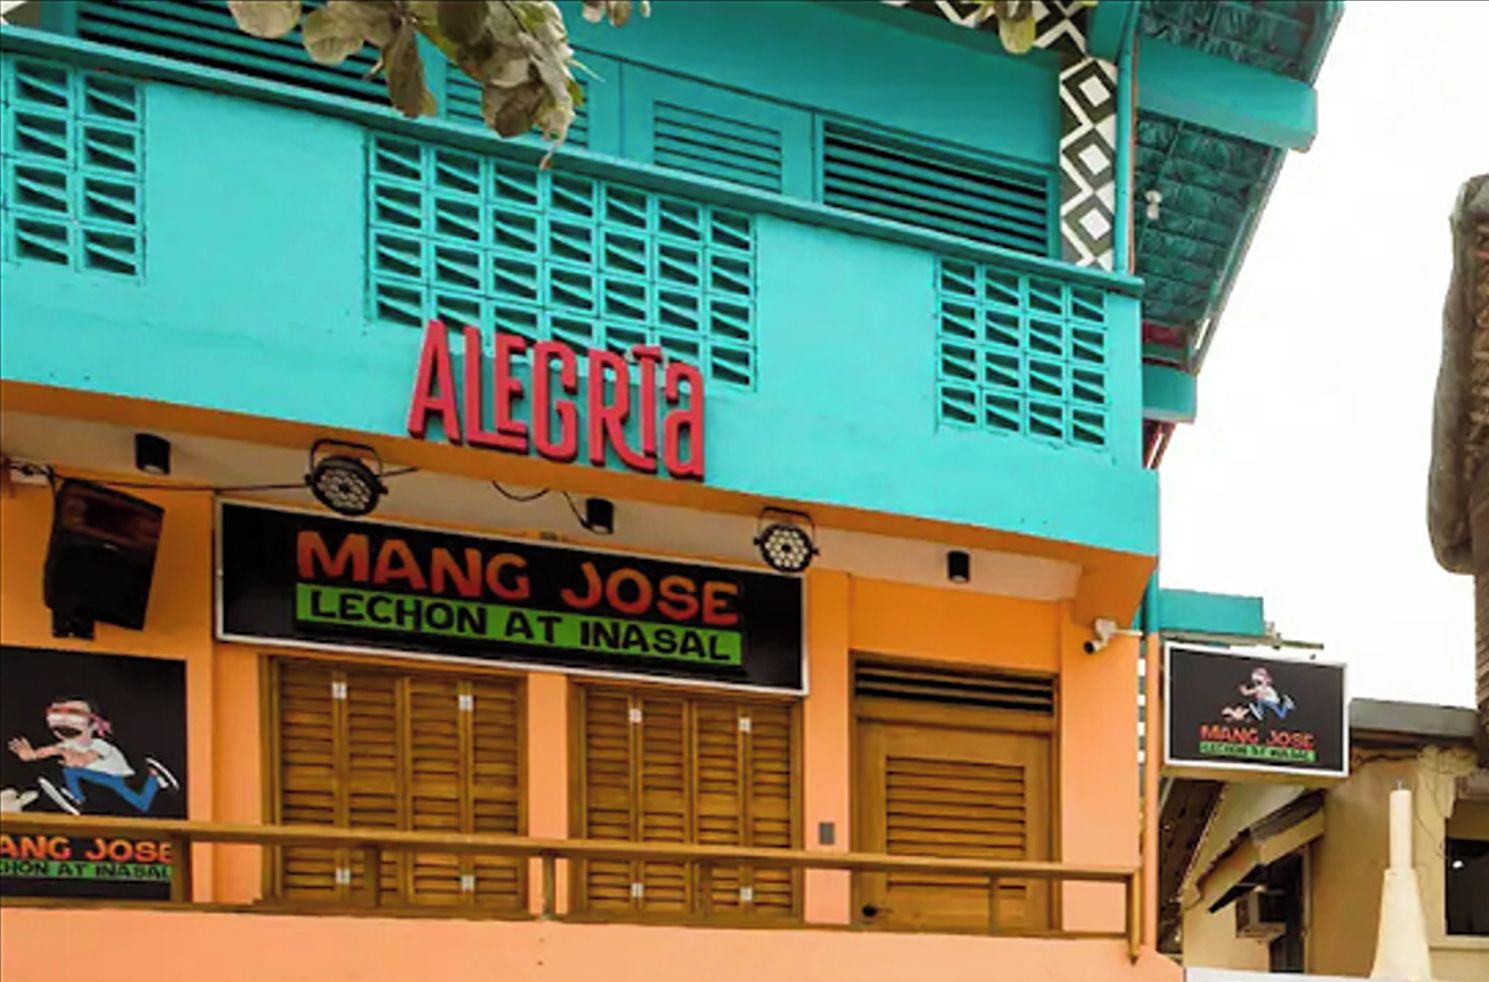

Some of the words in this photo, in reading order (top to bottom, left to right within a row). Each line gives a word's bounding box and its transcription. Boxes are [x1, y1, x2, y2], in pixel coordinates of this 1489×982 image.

[297, 530, 530, 600] MANG
[561, 561, 740, 625] JOSE
[310, 590, 488, 635] LECHON
[504, 611, 563, 644] AT
[579, 619, 731, 661] INASAL
[1199, 724, 1259, 744] MANG
[1265, 730, 1314, 750] JOSE
[85, 838, 173, 864] JOSE
[57, 862, 88, 877] AT
